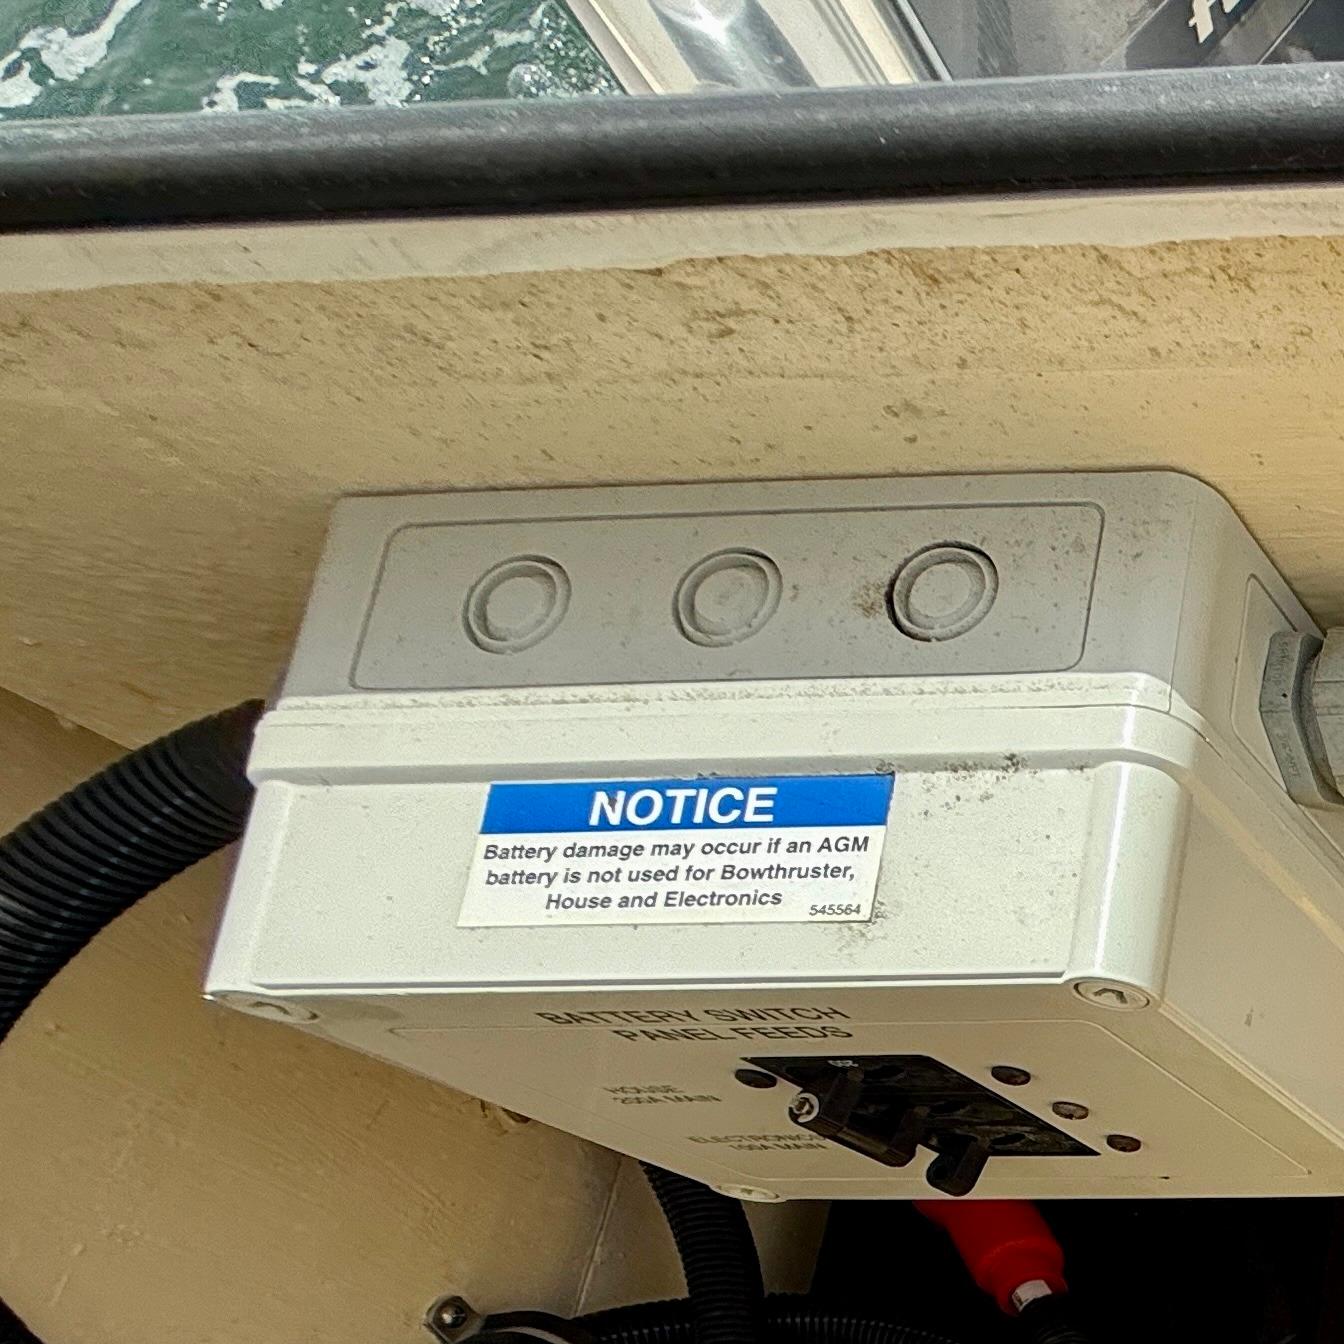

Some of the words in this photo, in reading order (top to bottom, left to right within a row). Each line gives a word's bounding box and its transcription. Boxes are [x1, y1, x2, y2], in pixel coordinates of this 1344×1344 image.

[588, 786, 778, 827] NOTICE
[483, 843, 557, 863] Battery
[563, 841, 644, 861] damage
[650, 842, 691, 861] may
[700, 838, 762, 856] occur
[766, 836, 783, 854] if
[785, 838, 812, 854] an
[816, 836, 870, 854] AGM
[485, 868, 559, 888] battery
[563, 868, 582, 884] is
[587, 867, 622, 883] not
[628, 865, 679, 882] used
[685, 864, 714, 882] for
[720, 862, 856, 882] Bowthruster,
[545, 893, 613, 910] House
[618, 891, 658, 909] and
[663, 889, 783, 908] Electronics
[809, 904, 862, 916] 545564
[536, 1009, 702, 1025] BATTERY
[703, 1006, 852, 1023] SWITCH
[611, 1027, 737, 1041] PANEL
[730, 1025, 853, 1039] FEEDS
